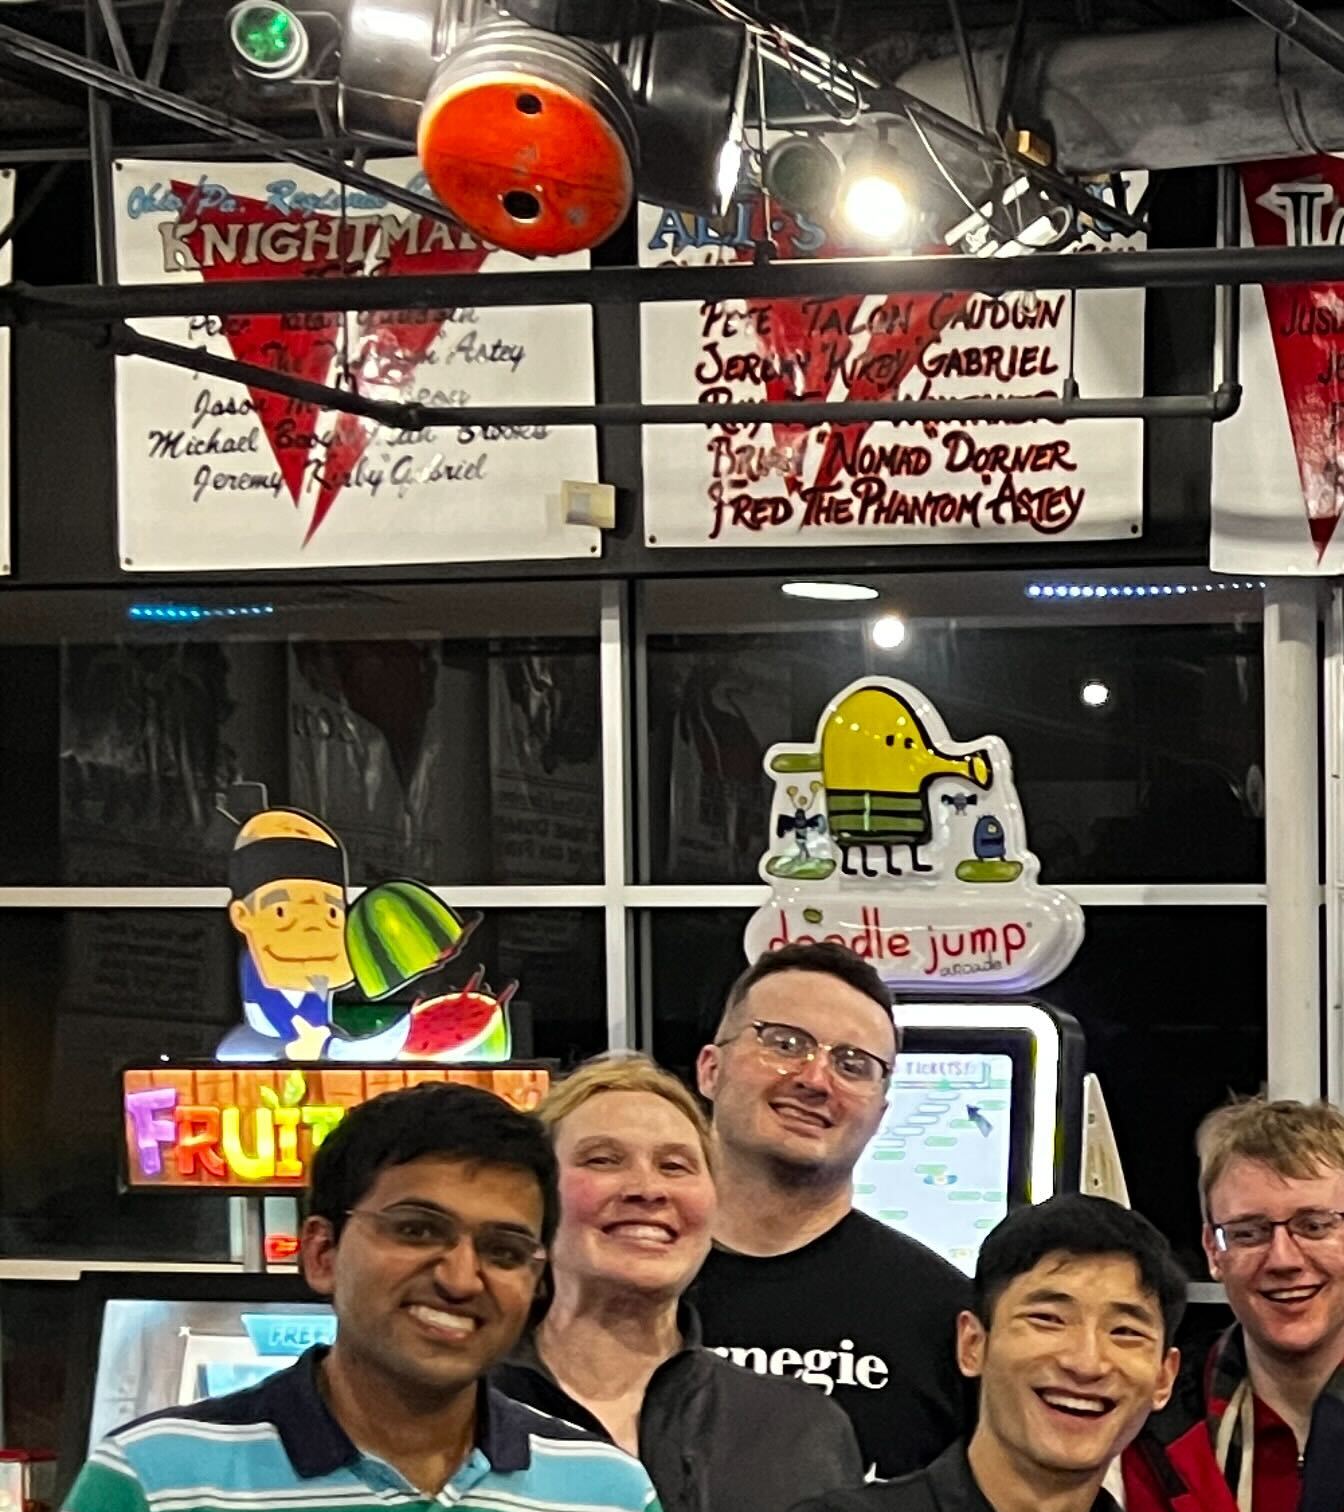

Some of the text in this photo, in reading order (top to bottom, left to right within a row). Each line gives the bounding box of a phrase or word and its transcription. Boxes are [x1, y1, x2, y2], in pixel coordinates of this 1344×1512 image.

[157, 211, 499, 273] KNIGHTMAR
[919, 343, 1060, 383] GABRIEL
[148, 427, 259, 459] Michael
[943, 431, 1078, 474] DORNER
[193, 463, 284, 502] Jeremy
[985, 475, 1086, 535] ASTEY
[923, 921, 1027, 975] jump
[701, 1339, 889, 1396] negie
